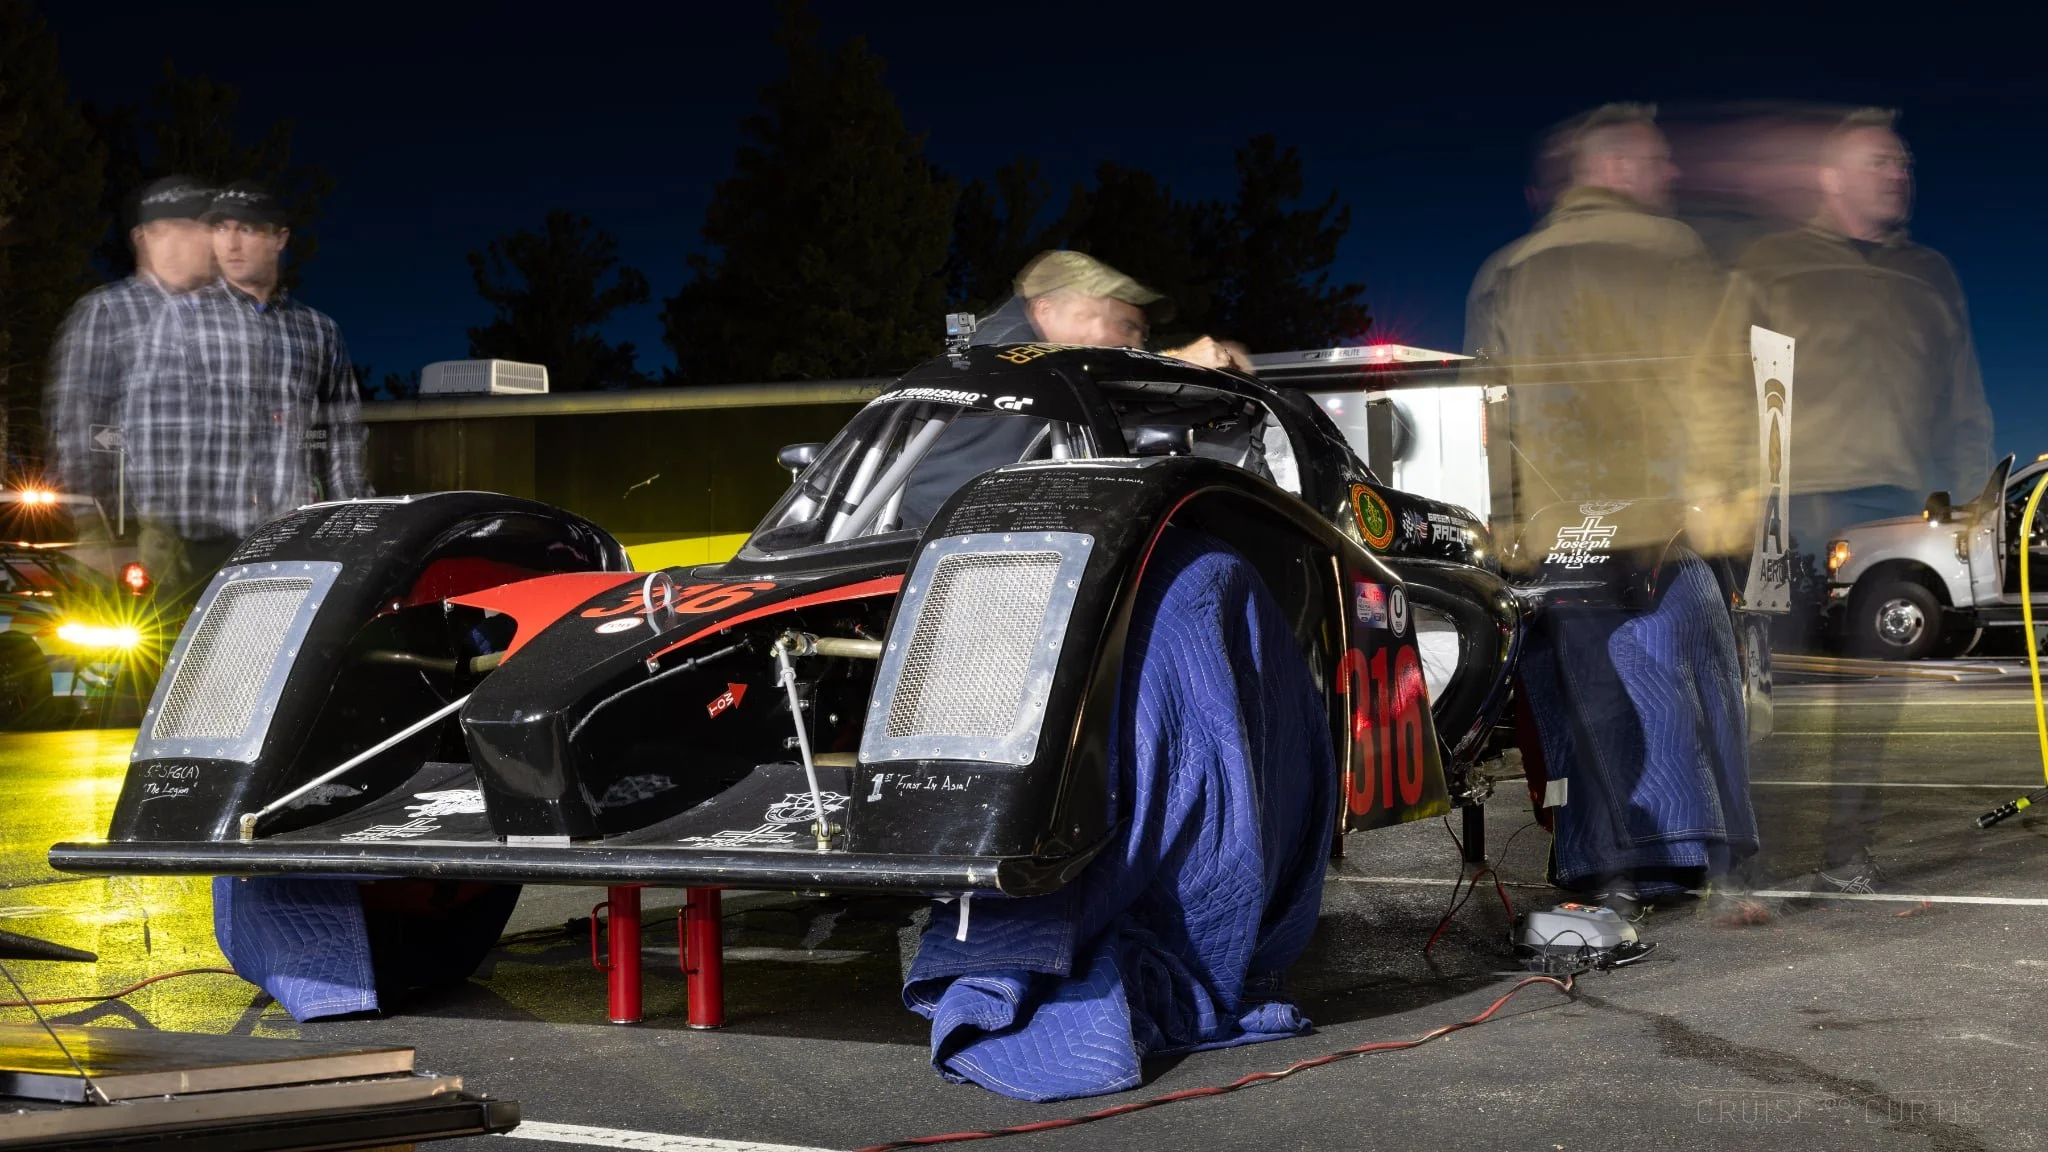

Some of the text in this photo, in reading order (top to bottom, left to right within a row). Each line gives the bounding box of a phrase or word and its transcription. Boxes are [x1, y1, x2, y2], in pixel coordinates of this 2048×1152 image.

[900, 388, 980, 402] TURISMO
[1550, 537, 1611, 551] Joseph
[1544, 552, 1611, 564] Phister
[709, 692, 735, 716] TOW
[1336, 644, 1425, 816] 316
